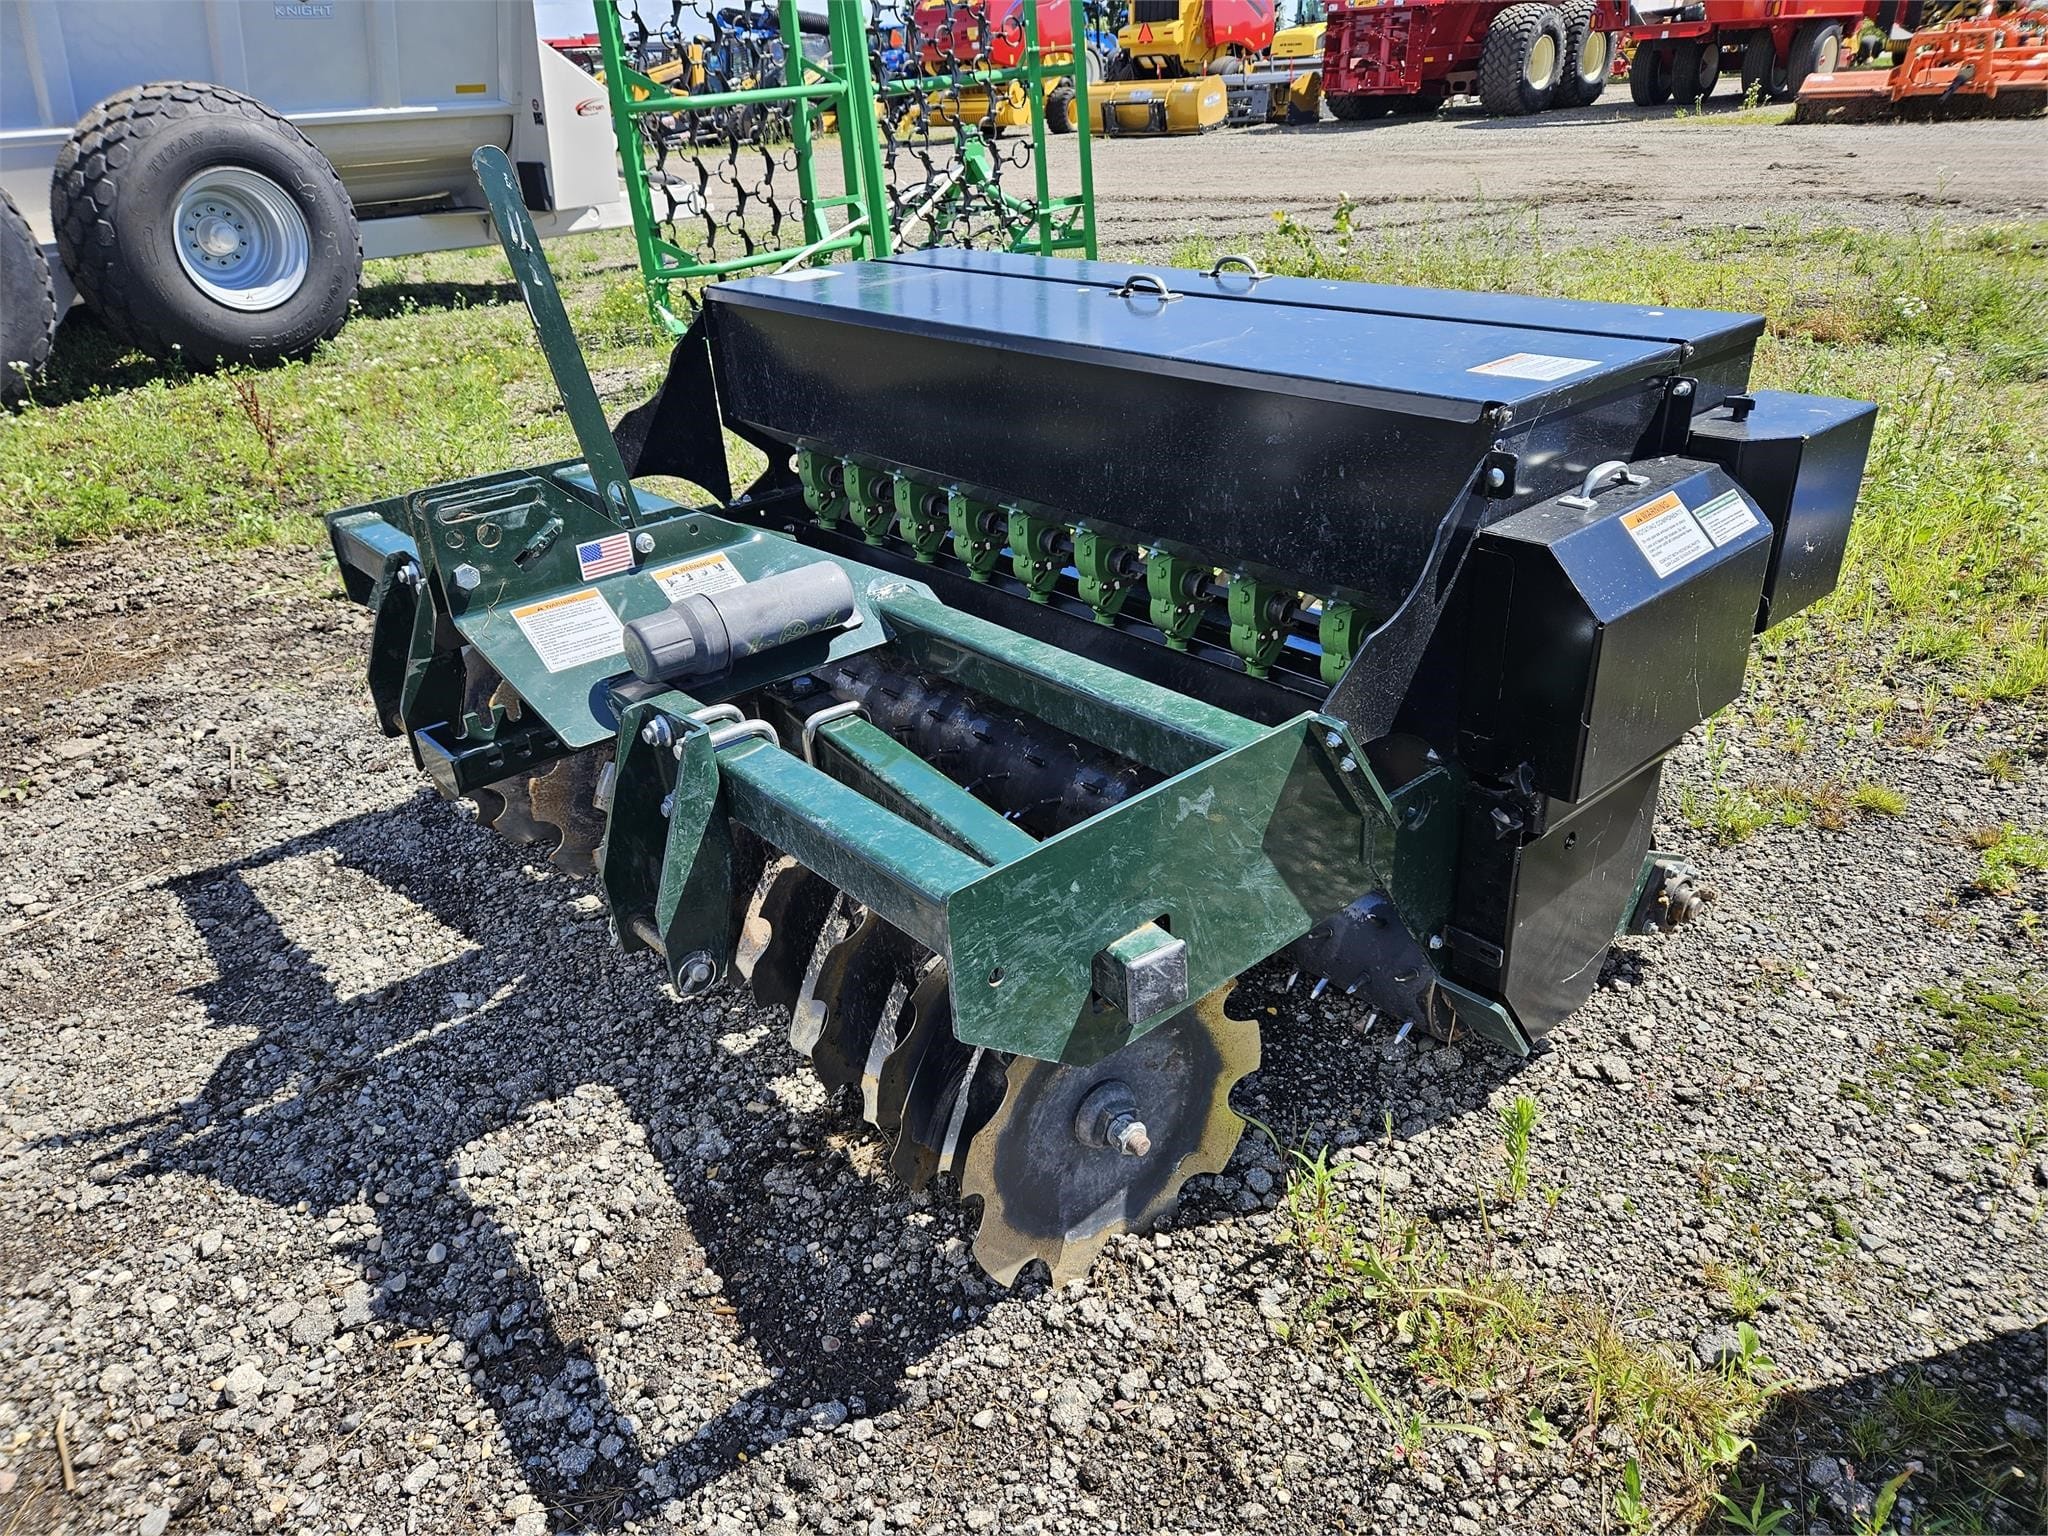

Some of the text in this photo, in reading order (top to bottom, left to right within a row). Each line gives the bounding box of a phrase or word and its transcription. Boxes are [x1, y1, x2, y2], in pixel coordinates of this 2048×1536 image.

[275, 4, 332, 16] KNIGHT
[1640, 500, 1670, 520] WARNING
[679, 560, 711, 573] WARNING
[545, 597, 579, 610] WARNING
